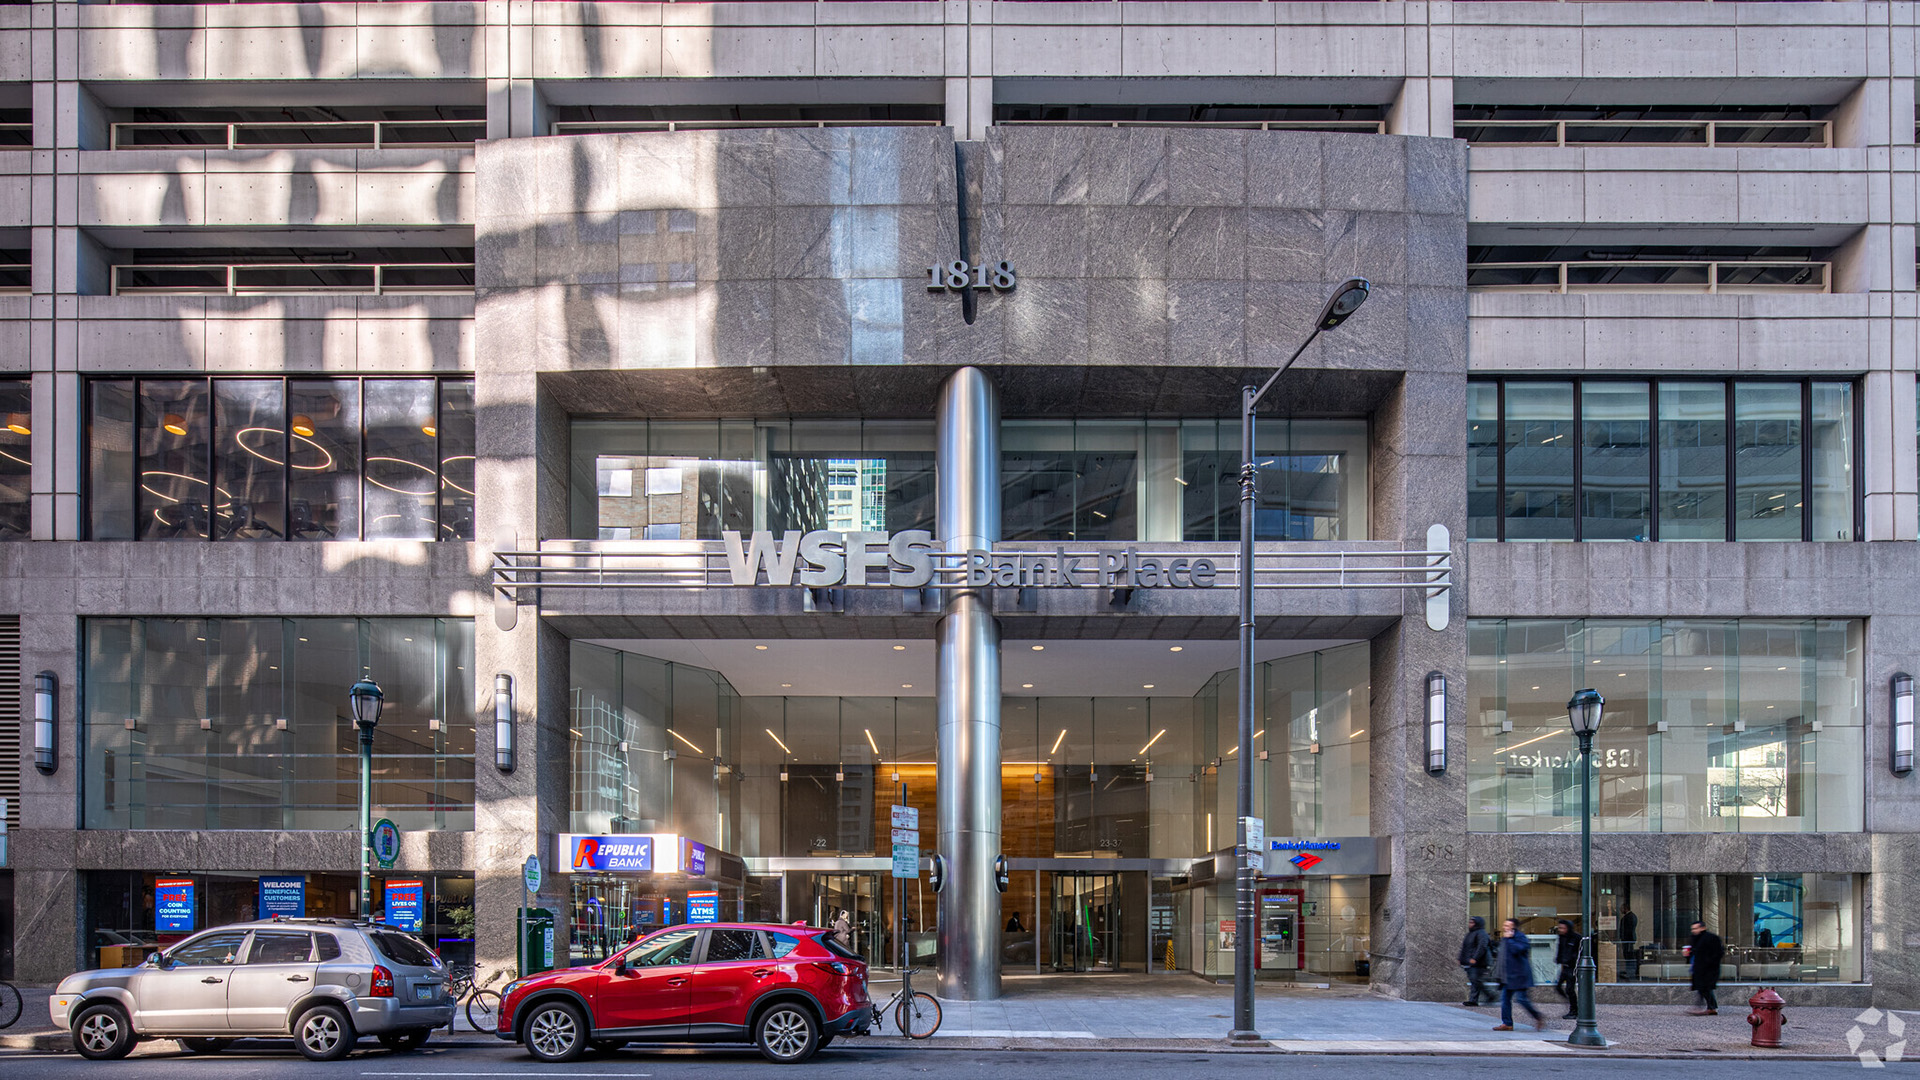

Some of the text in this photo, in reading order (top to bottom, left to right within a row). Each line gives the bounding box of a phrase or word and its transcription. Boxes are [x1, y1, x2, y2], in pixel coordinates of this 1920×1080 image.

[927, 260, 1016, 291] 1818
[722, 530, 1218, 588] WSFS Bank Place
[1270, 841, 1293, 850] Bank
[1304, 841, 1341, 850] America
[574, 839, 648, 867] REPUBLIC
[1420, 844, 1453, 860] 1818
[608, 858, 643, 867] BANK
[162, 894, 187, 902] FREE
[392, 893, 416, 901] FREE
[691, 907, 714, 915] ATMS
